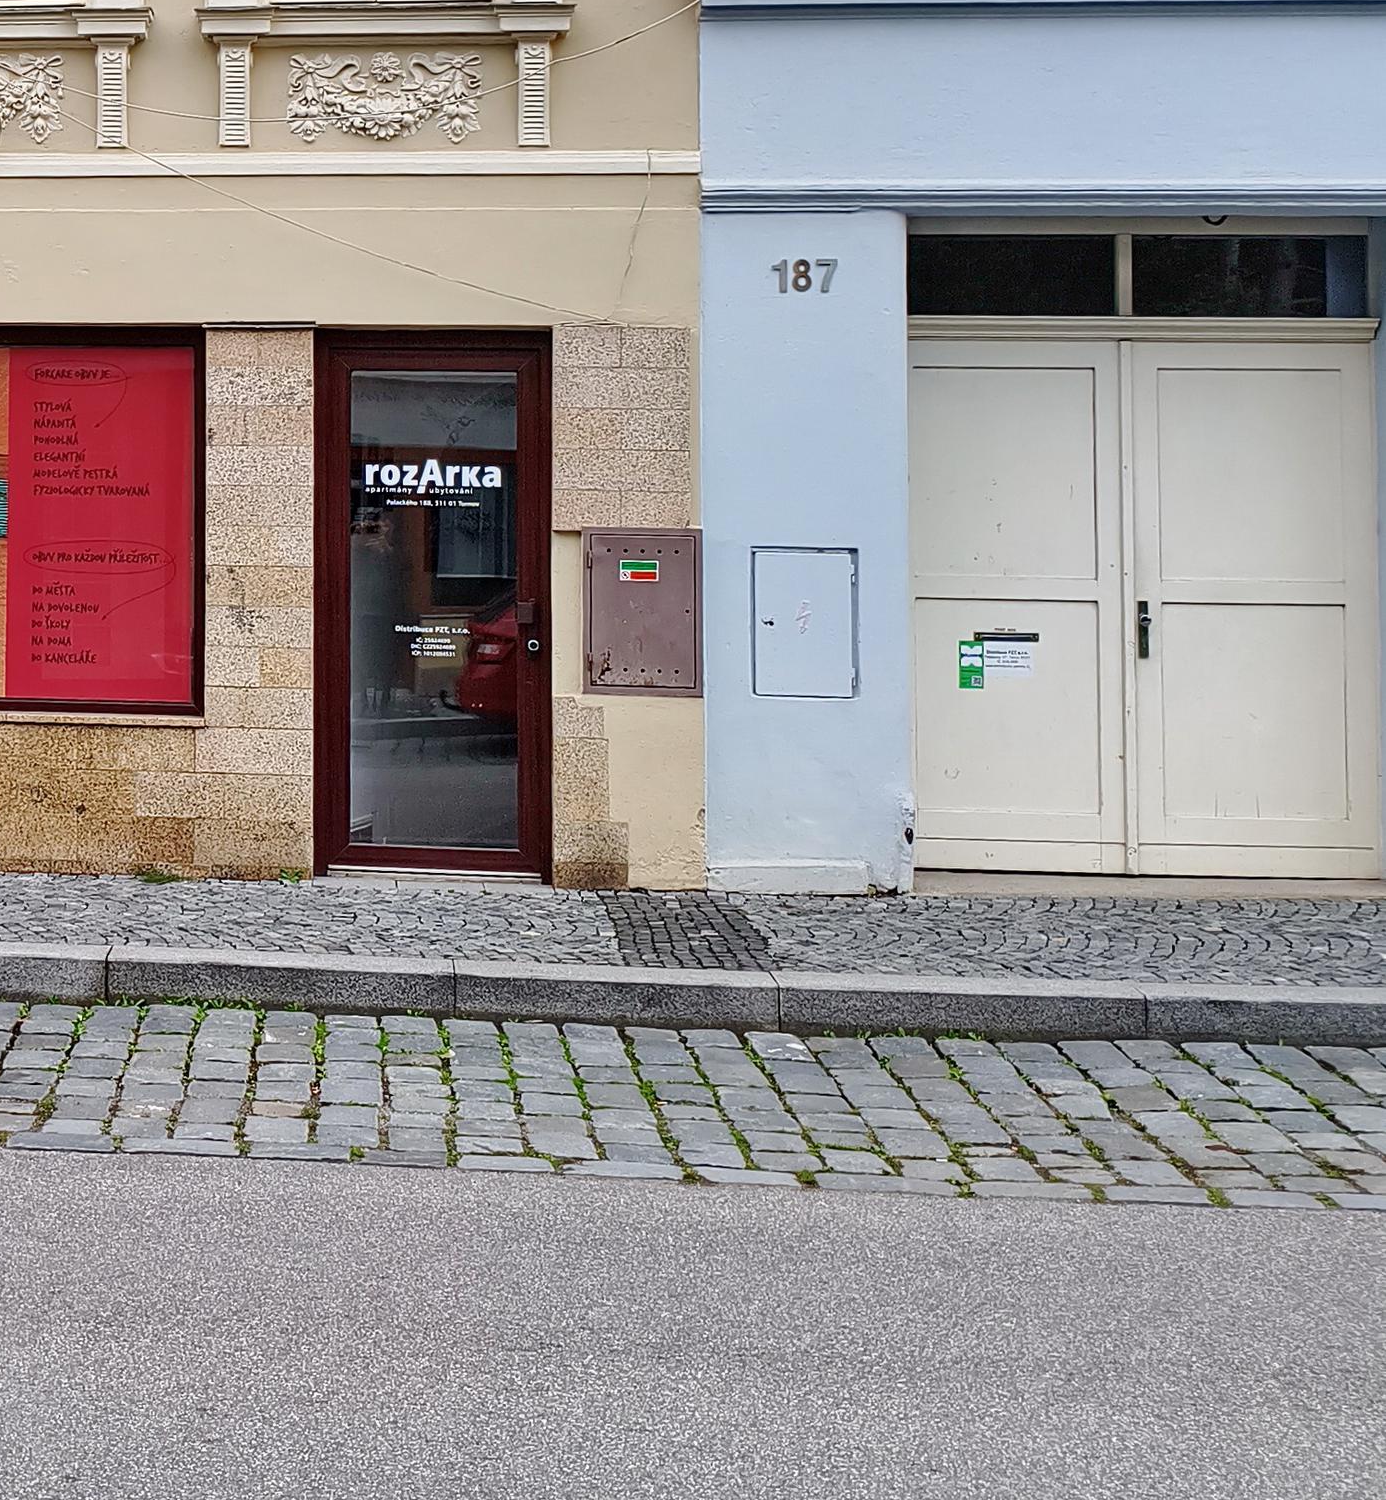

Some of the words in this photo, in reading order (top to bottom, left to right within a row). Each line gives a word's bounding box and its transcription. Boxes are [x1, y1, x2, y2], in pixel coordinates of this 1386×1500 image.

[771, 258, 838, 294] 187
[33, 398, 72, 412] STYLOVÁ
[33, 415, 76, 429] NÁPADITÁ
[33, 432, 79, 445] POHODLNÁ
[33, 449, 86, 462] ELEGANTNÍ
[33, 465, 80, 479] MODELOVĚ
[83, 466, 118, 479] PESTRÁ
[33, 483, 95, 496] FYZIOLOGICKY
[96, 482, 150, 496] TVAROVANÁ
[365, 486, 412, 495] apartmány
[429, 487, 473, 495] ubytování
[57, 552, 72, 563] PRO
[32, 585, 43, 595] DO
[45, 581, 76, 596] MĚSTA
[32, 602, 44, 612] NA
[47, 602, 99, 613] DOVOLENOU
[31, 619, 43, 628] DO
[45, 615, 71, 630] ŠKOLY
[31, 635, 43, 646] NA
[47, 636, 72, 646] DOMA
[31, 653, 42, 662] DO
[45, 649, 97, 665] KANCELÁŘE
